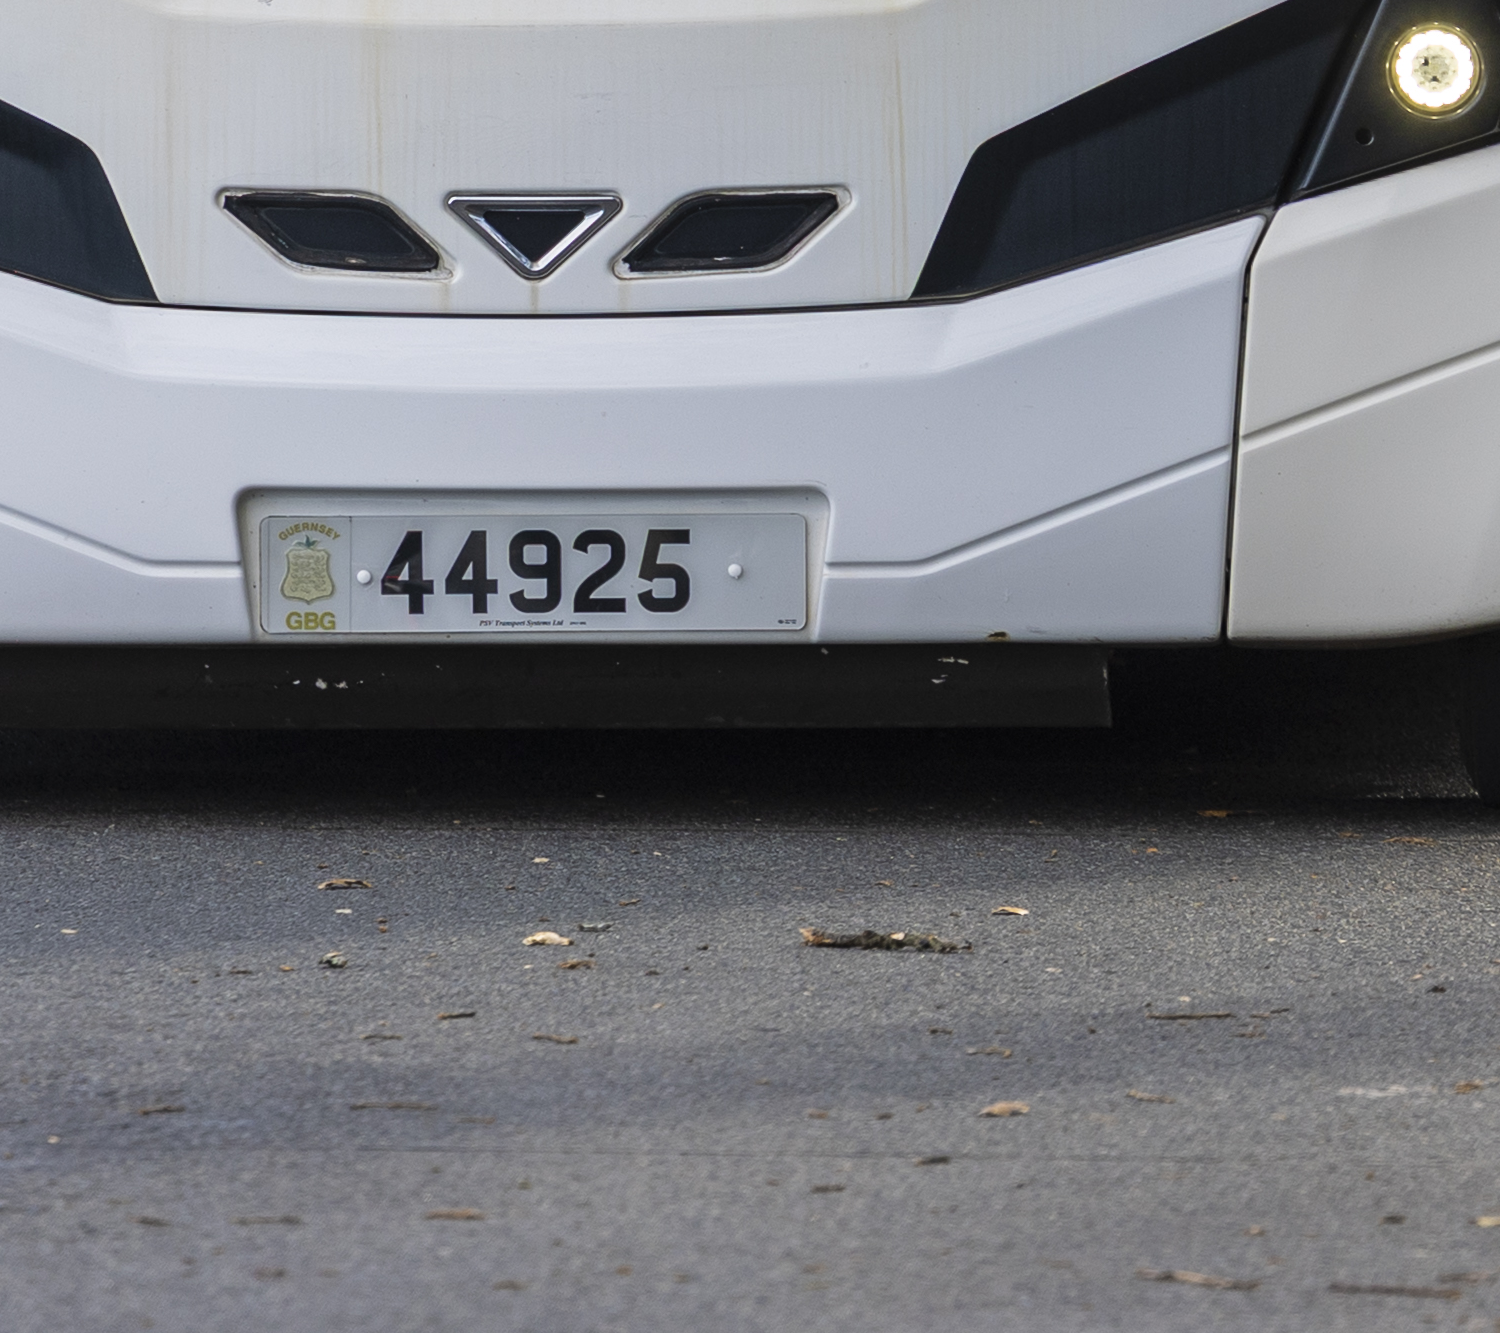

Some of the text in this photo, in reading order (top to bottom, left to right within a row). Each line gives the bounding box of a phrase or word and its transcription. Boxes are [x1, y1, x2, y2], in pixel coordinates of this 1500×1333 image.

[278, 522, 341, 541] GUERNSEY
[380, 528, 691, 615] 44925
[285, 611, 336, 630] GBG
